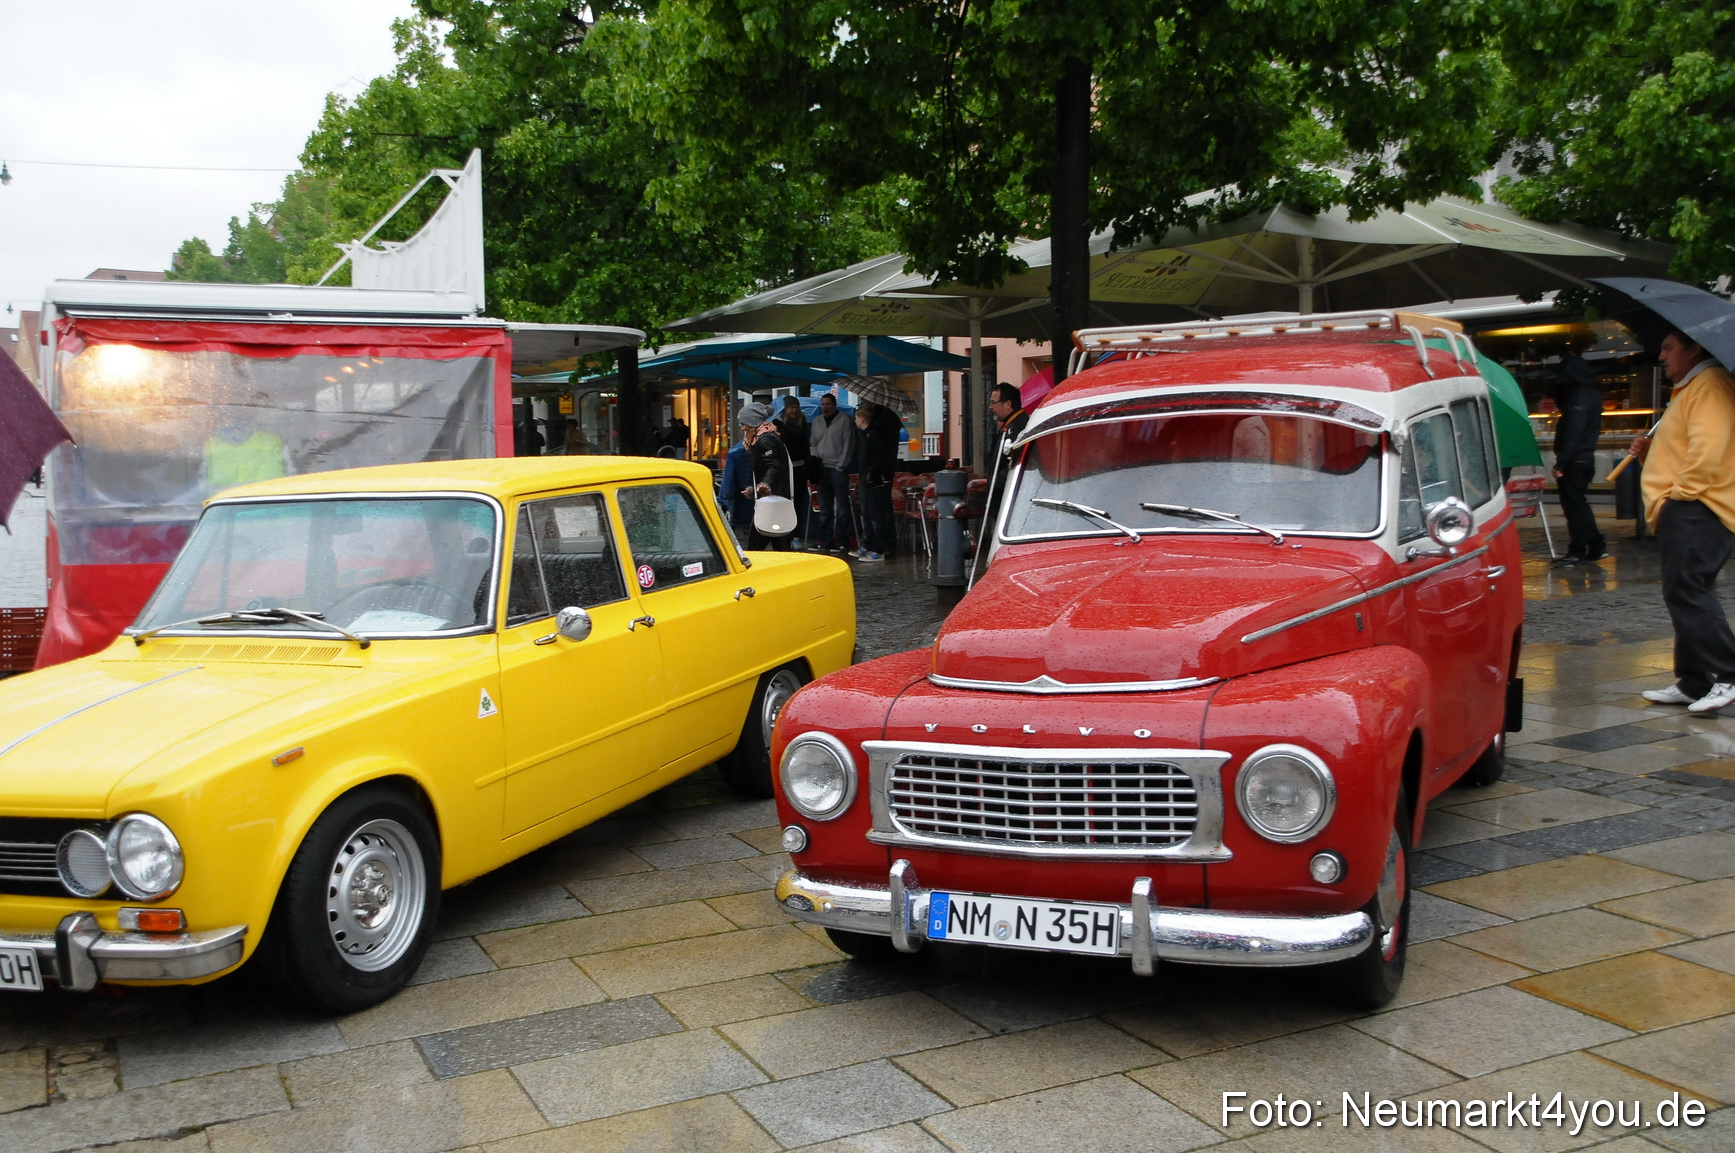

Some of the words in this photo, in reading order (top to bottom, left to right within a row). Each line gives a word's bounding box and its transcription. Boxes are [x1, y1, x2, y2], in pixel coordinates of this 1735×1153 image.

[638, 567, 653, 585] STP
[924, 723, 1152, 738] VOLVO
[933, 919, 942, 931] D
[947, 899, 992, 937] NM
[1015, 905, 1038, 941] N
[1045, 907, 1115, 948] 35H
